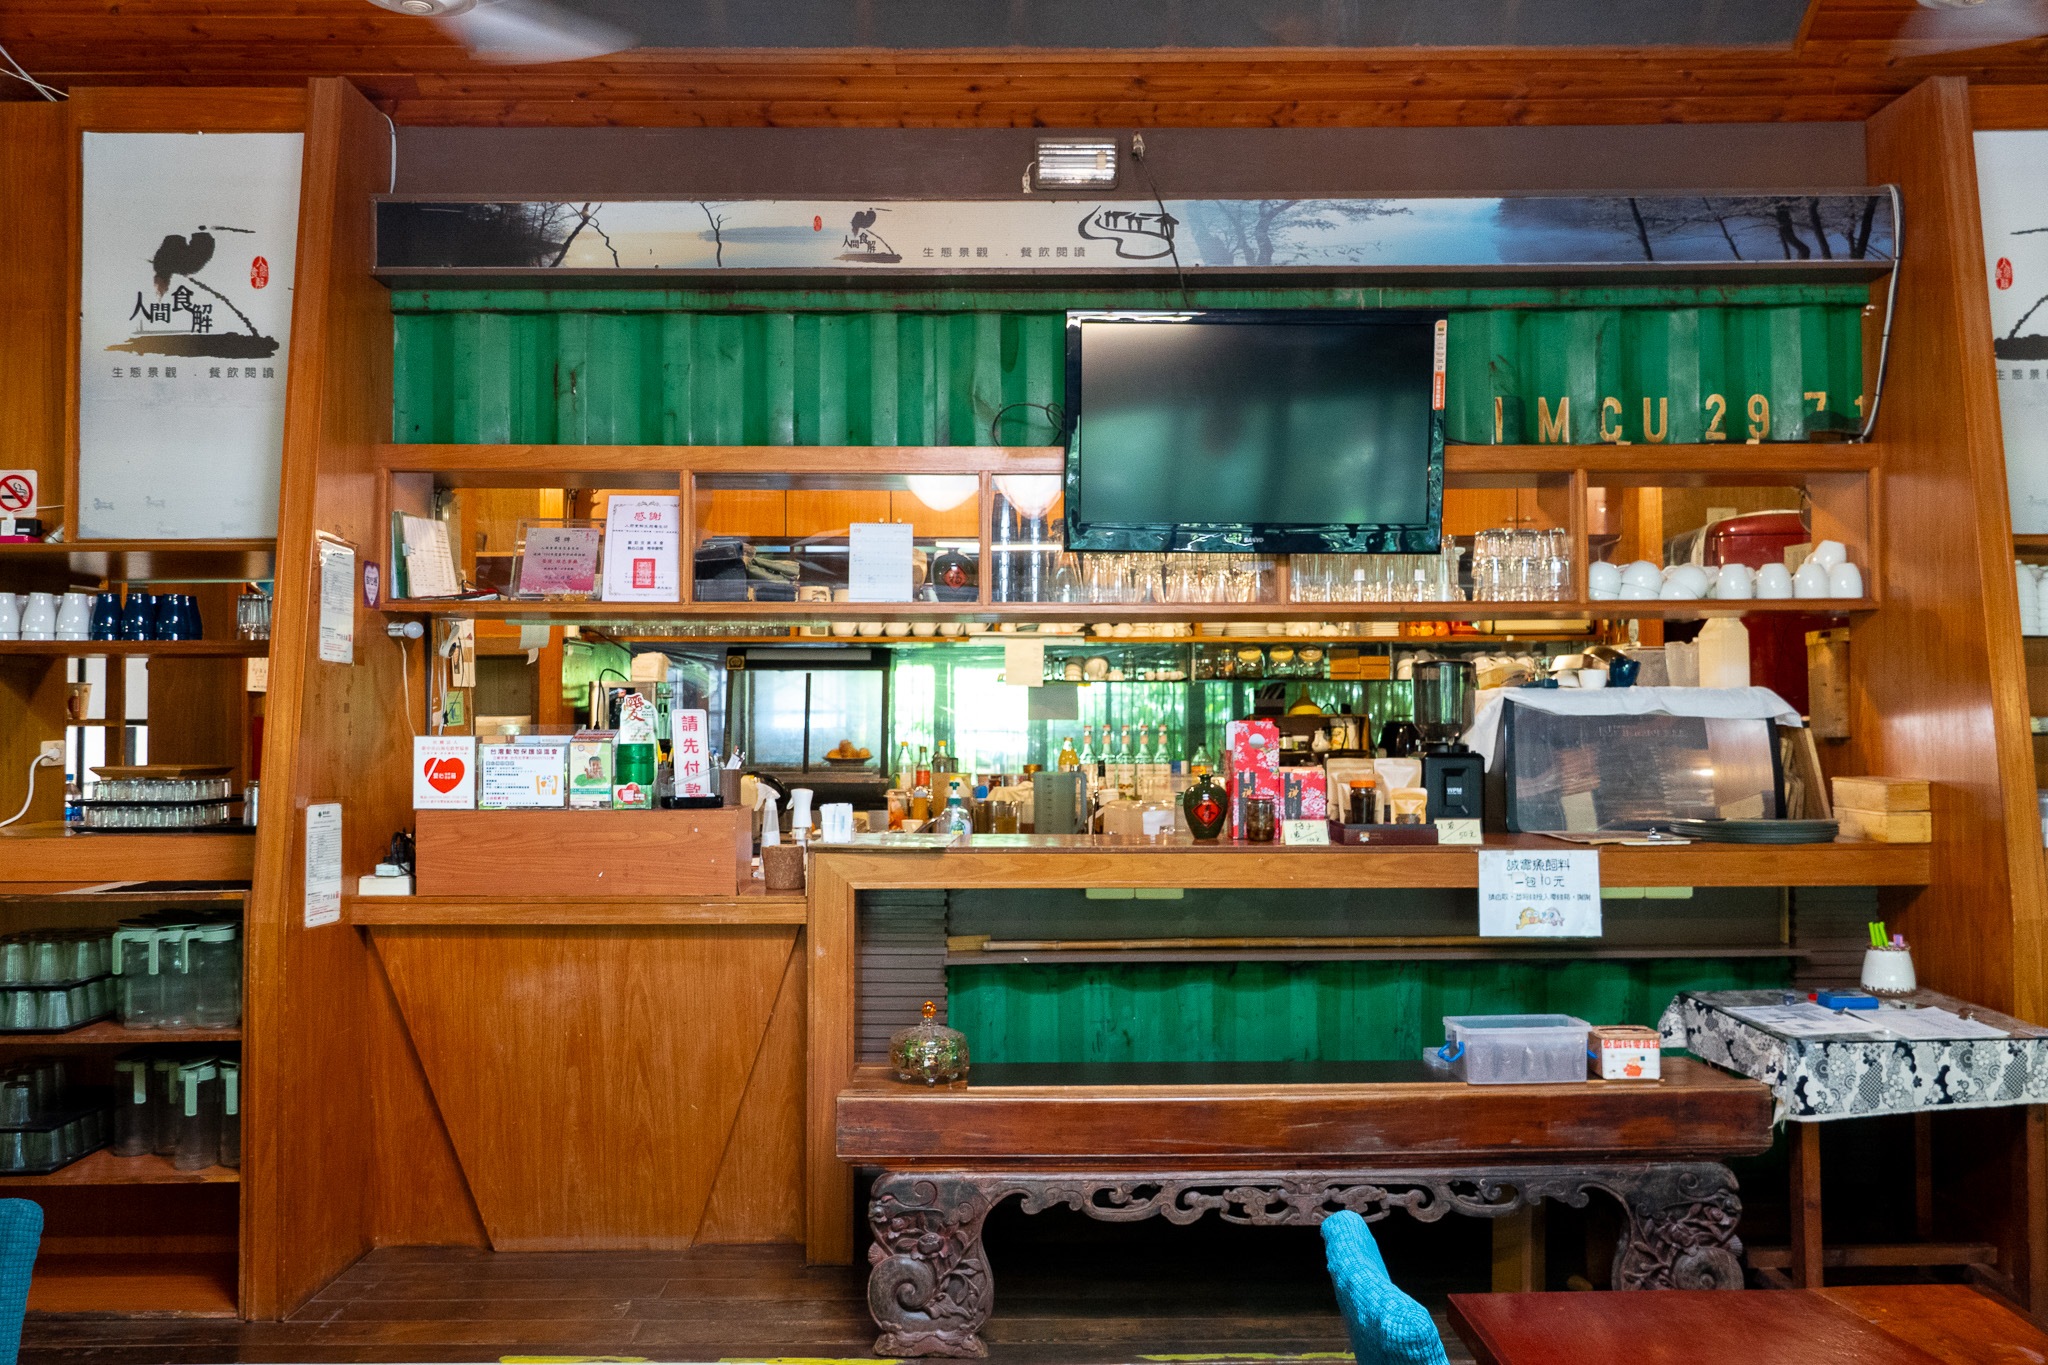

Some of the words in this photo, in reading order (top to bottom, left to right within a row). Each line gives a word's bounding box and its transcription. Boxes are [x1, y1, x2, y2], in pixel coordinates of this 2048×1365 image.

[842, 232, 877, 254] 人間食解
[129, 285, 213, 333] 人間食解
[112, 367, 177, 379] 生態景觀
[634, 511, 662, 521] 感謝
[1447, 787, 1463, 795] WPM
